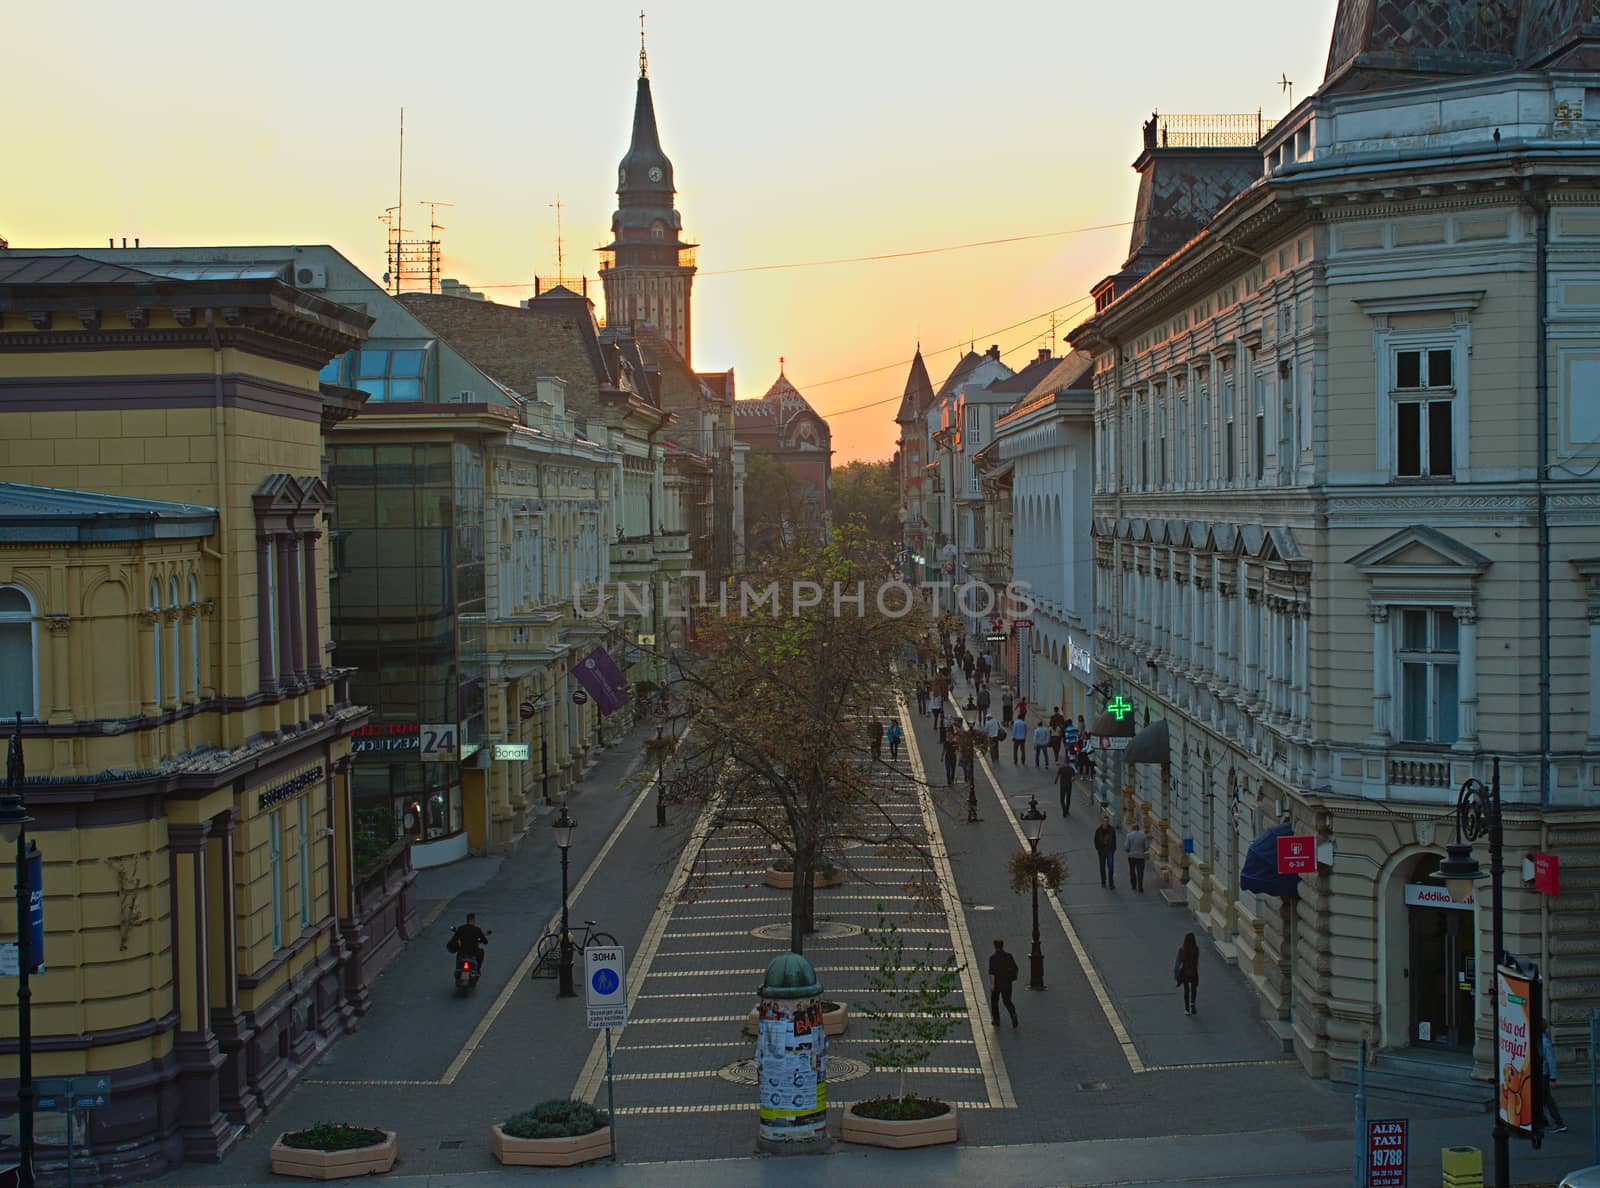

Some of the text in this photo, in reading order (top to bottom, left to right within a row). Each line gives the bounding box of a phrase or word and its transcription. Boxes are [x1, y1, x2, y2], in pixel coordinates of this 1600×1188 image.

[423, 731, 455, 754] 24
[495, 744, 529, 758] Bonatti
[1417, 891, 1450, 903] Addiko
[592, 952, 617, 962] ЗОНА
[1513, 1023, 1526, 1038] od
[1373, 1124, 1402, 1134] ALFA
[1373, 1136, 1402, 1145] TAXI
[1372, 1149, 1402, 1167] 19788
